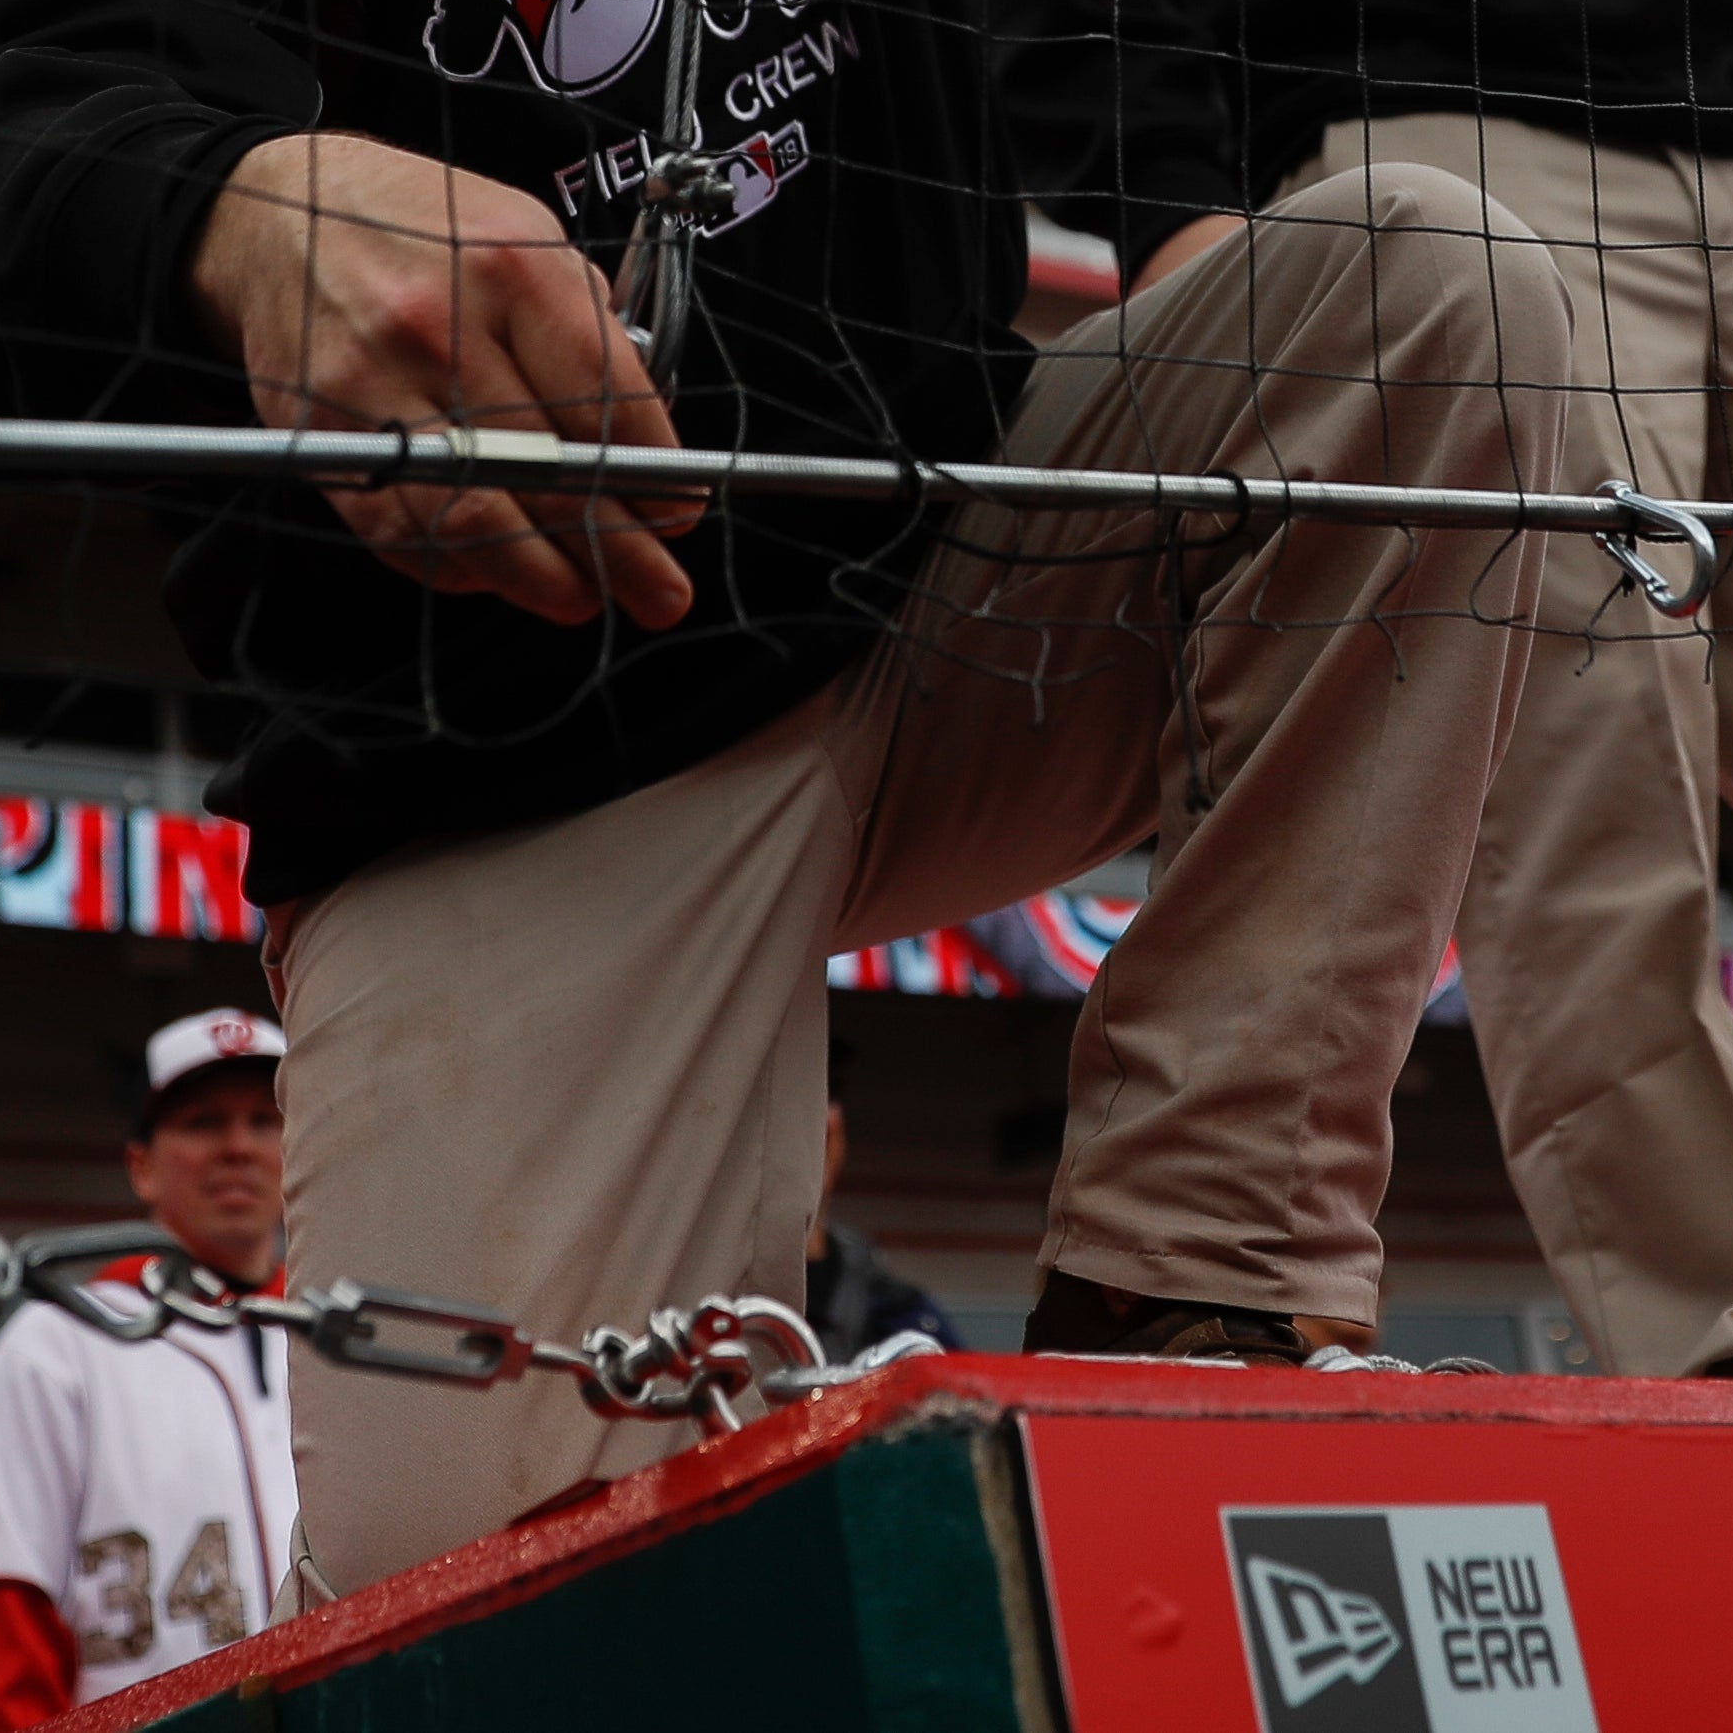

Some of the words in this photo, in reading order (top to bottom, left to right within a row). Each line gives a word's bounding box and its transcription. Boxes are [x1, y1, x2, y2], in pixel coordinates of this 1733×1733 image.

[554, 109, 704, 217] FIEL
[725, 21, 861, 122] CREW
[79, 1521, 246, 1663] 34
[1425, 1557, 1543, 1622] NEW
[1441, 1626, 1561, 1691] ERA
